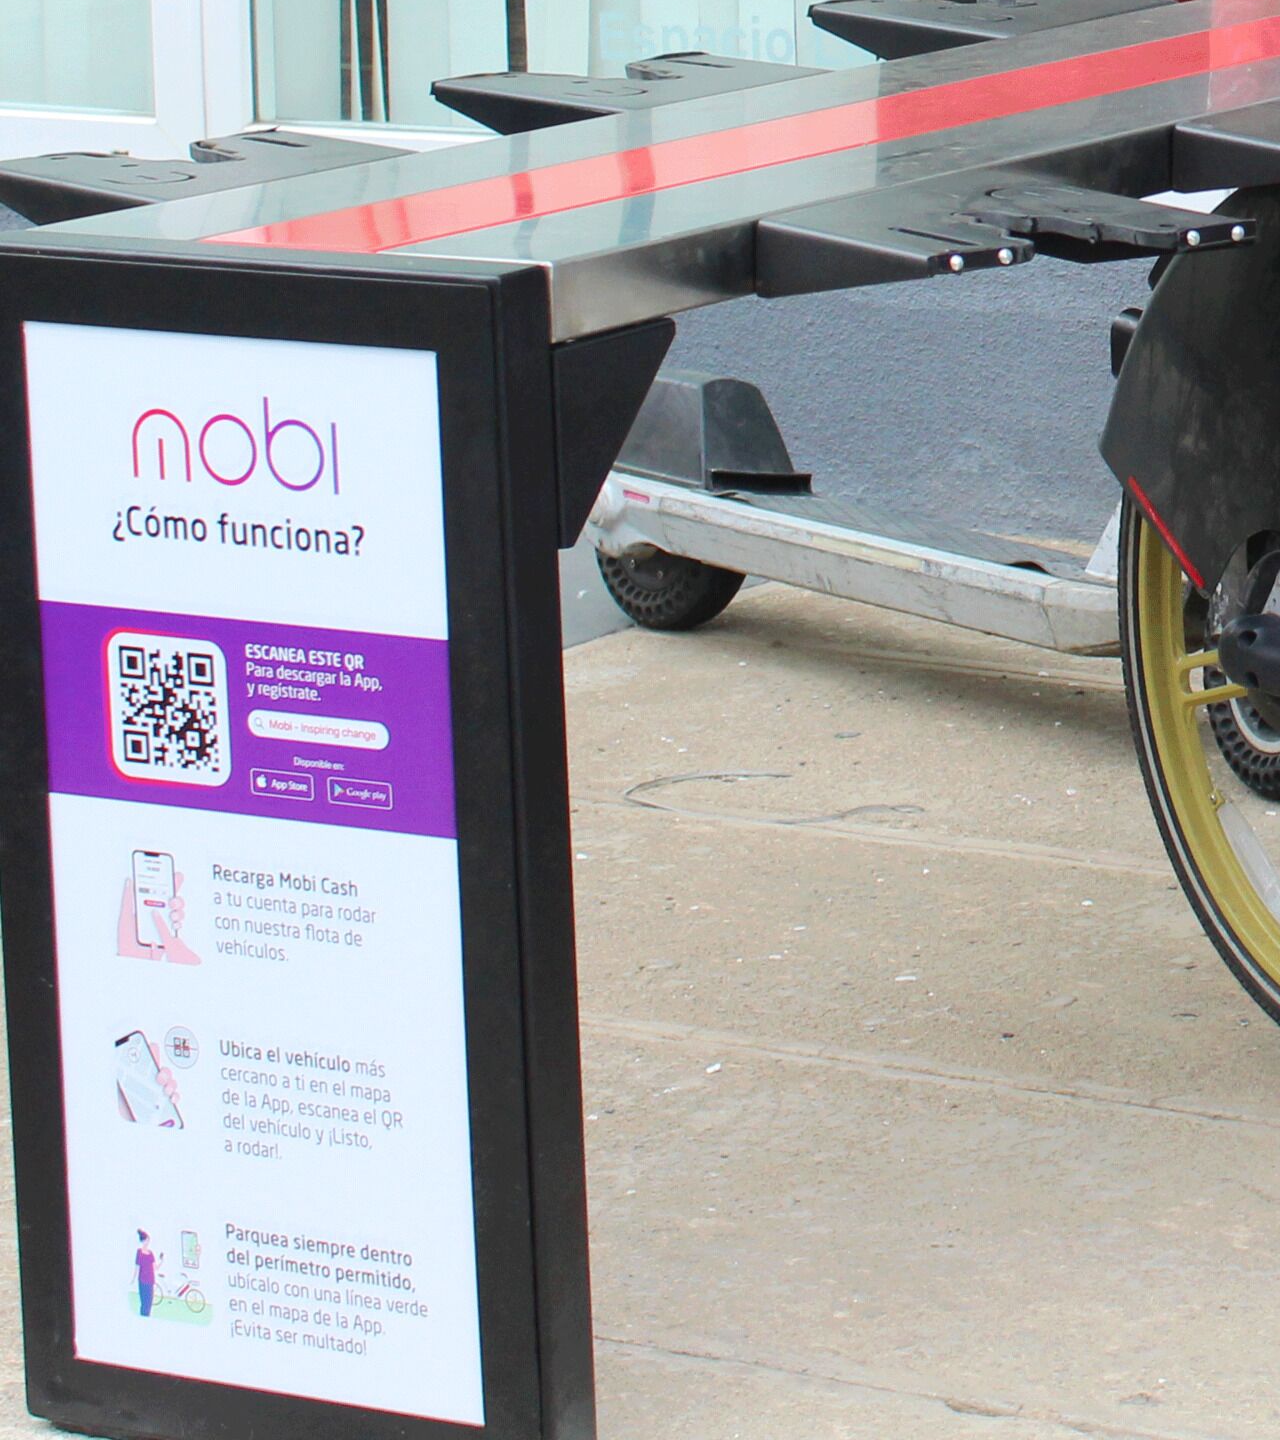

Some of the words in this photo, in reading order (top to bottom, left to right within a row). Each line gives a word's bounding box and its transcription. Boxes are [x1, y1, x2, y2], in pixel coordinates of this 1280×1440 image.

[132, 396, 340, 495] mobi
[112, 505, 208, 542] ¿Cómo
[217, 512, 365, 556] funciona?
[245, 643, 306, 664] ESCANEA
[309, 650, 342, 667] ESTE
[344, 653, 365, 671] QR
[246, 662, 274, 678] Para
[276, 665, 336, 687] descargar
[339, 671, 351, 686] la
[354, 673, 383, 692] App,
[247, 682, 255, 697] y
[257, 683, 322, 701] regístrate.
[269, 719, 292, 730] Mobi
[301, 723, 341, 738] Inspiring
[341, 728, 376, 741] change
[293, 756, 332, 770] Disponible
[271, 779, 288, 791] App
[288, 780, 309, 792] Store
[346, 787, 371, 800] Google
[212, 864, 274, 889] Recarga
[279, 872, 316, 892] Mobi
[321, 877, 358, 897] Cash
[213, 891, 222, 905] a
[227, 891, 242, 907] tu
[247, 895, 297, 914] cuenta
[301, 902, 333, 919] para
[338, 906, 376, 924] rodar
[215, 915, 240, 932] con
[244, 918, 300, 939] nuestra
[306, 924, 340, 944] flota
[344, 929, 363, 947] de
[216, 939, 289, 962] vehículos.
[220, 1039, 262, 1061] Ubica
[267, 1046, 280, 1063] el
[285, 1050, 351, 1073] vehículo
[355, 1059, 386, 1078] más
[221, 1066, 278, 1087] cercano
[282, 1076, 290, 1089] a
[295, 1074, 305, 1091] ti
[310, 1079, 328, 1094] en
[332, 1080, 346, 1096] el
[350, 1084, 391, 1104] mapa
[222, 1088, 240, 1105] de
[244, 1091, 257, 1108] la
[261, 1093, 293, 1115] App,
[298, 1102, 359, 1122] escanea
[363, 1109, 377, 1125] el
[381, 1110, 403, 1130] QR
[223, 1112, 245, 1130] del
[249, 1117, 311, 1140] vehículo
[315, 1129, 324, 1145] y
[329, 1127, 373, 1150] ¡Listo,
[224, 1139, 233, 1152] a
[225, 1223, 289, 1248] Parquea
[293, 1234, 356, 1259] siempre
[360, 1244, 413, 1266] dentro
[226, 1248, 250, 1266] del
[255, 1253, 330, 1278] perímetro
[335, 1266, 416, 1293] permitido,
[228, 1272, 280, 1295] ubícalo
[284, 1283, 309, 1299] con
[314, 1288, 341, 1304] una
[345, 1288, 381, 1310] línea
[386, 1298, 429, 1318] verde
[229, 1298, 248, 1313] en
[252, 1300, 265, 1316] el
[269, 1304, 309, 1324] mapa
[313, 1309, 332, 1326] de
[336, 1312, 349, 1329] la
[353, 1314, 386, 1336] App.
[231, 1319, 272, 1340] ¡Evita
[276, 1329, 298, 1344] ser
[302, 1333, 367, 1356] multado!
